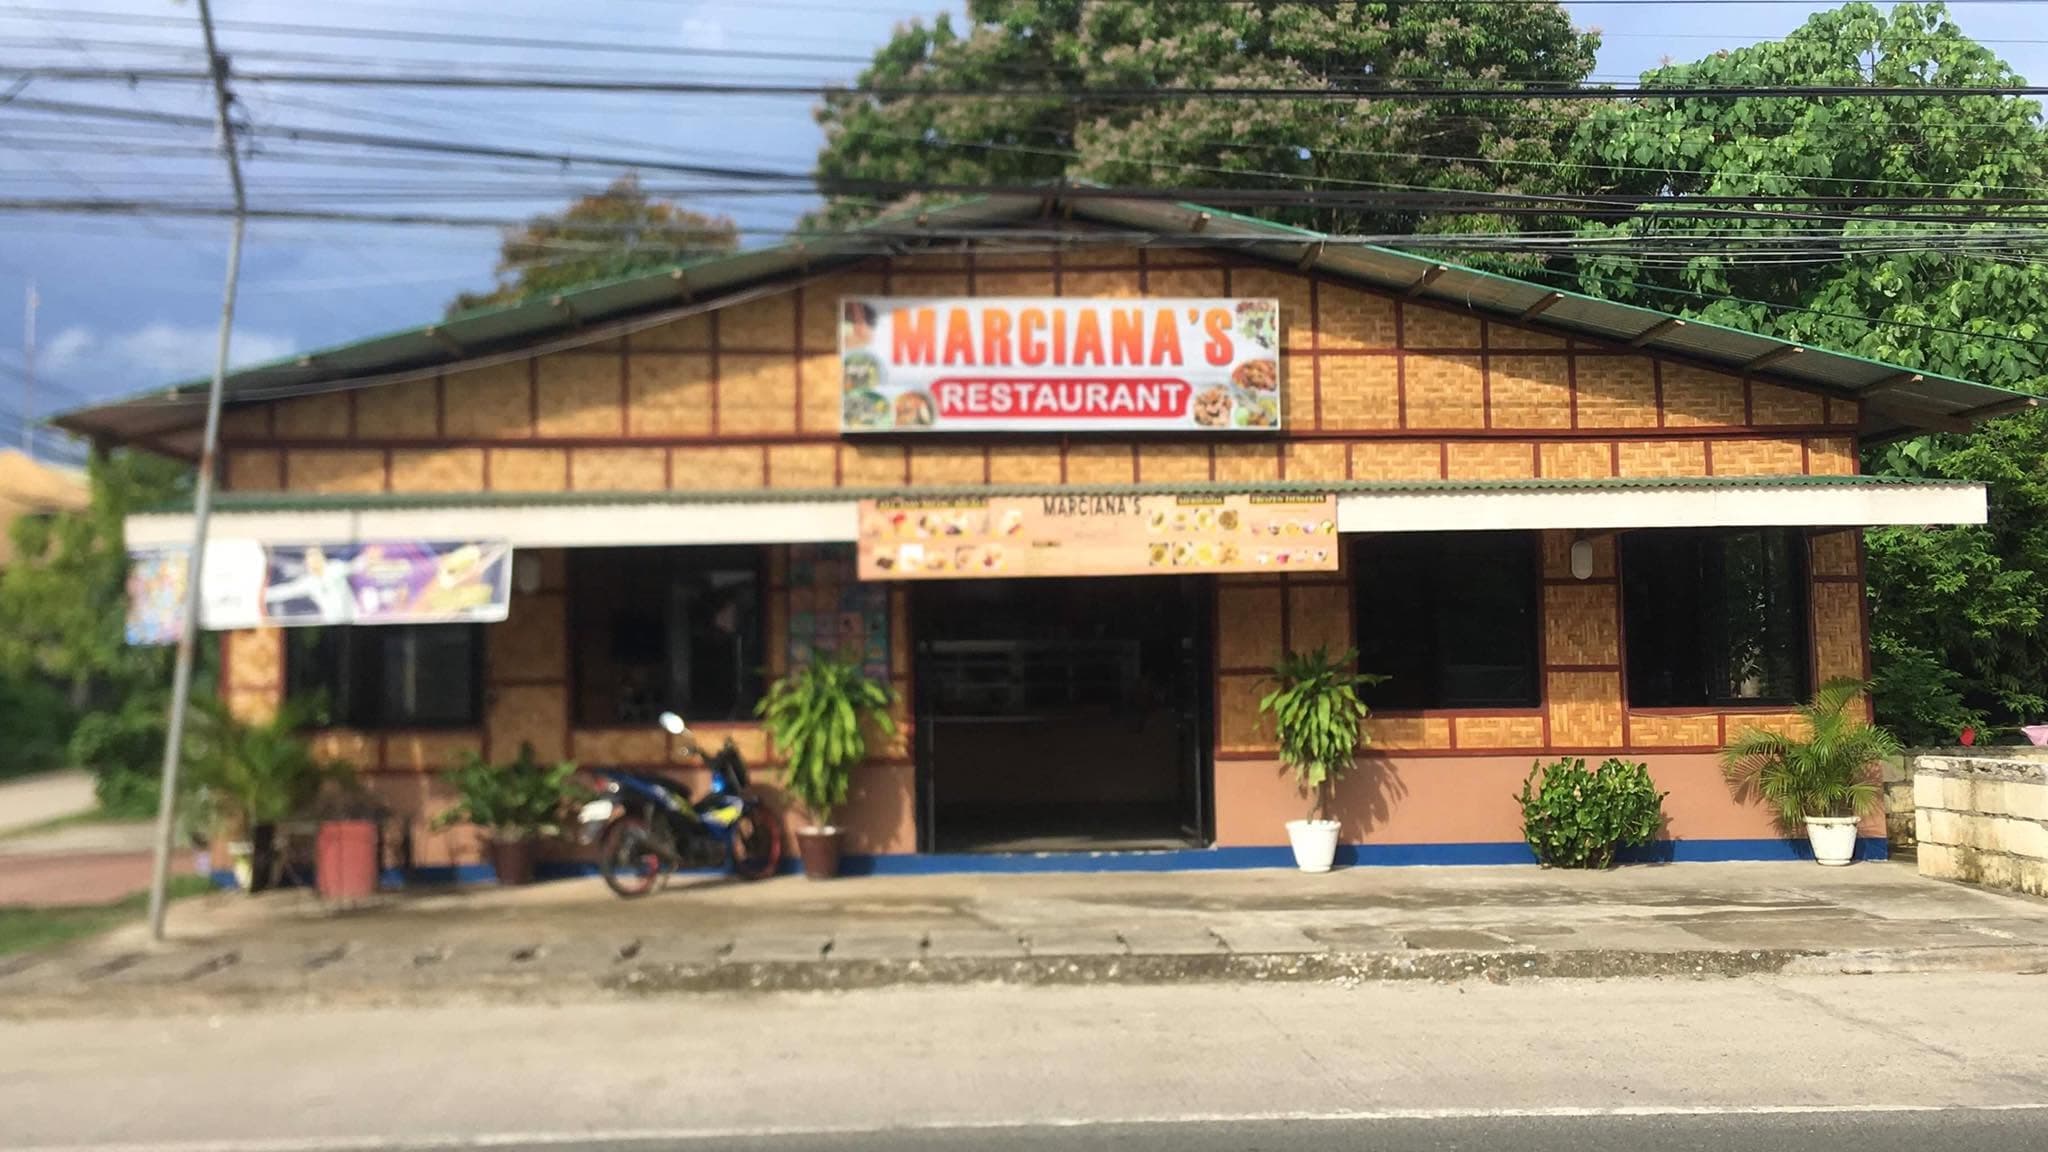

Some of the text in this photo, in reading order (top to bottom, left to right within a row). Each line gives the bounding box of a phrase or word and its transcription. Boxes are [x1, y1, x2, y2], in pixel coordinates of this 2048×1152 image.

[890, 305, 1235, 367] MARCIANA'S
[941, 382, 1185, 413] RESTAURANT
[1043, 496, 1142, 516] MARCIANA'S
